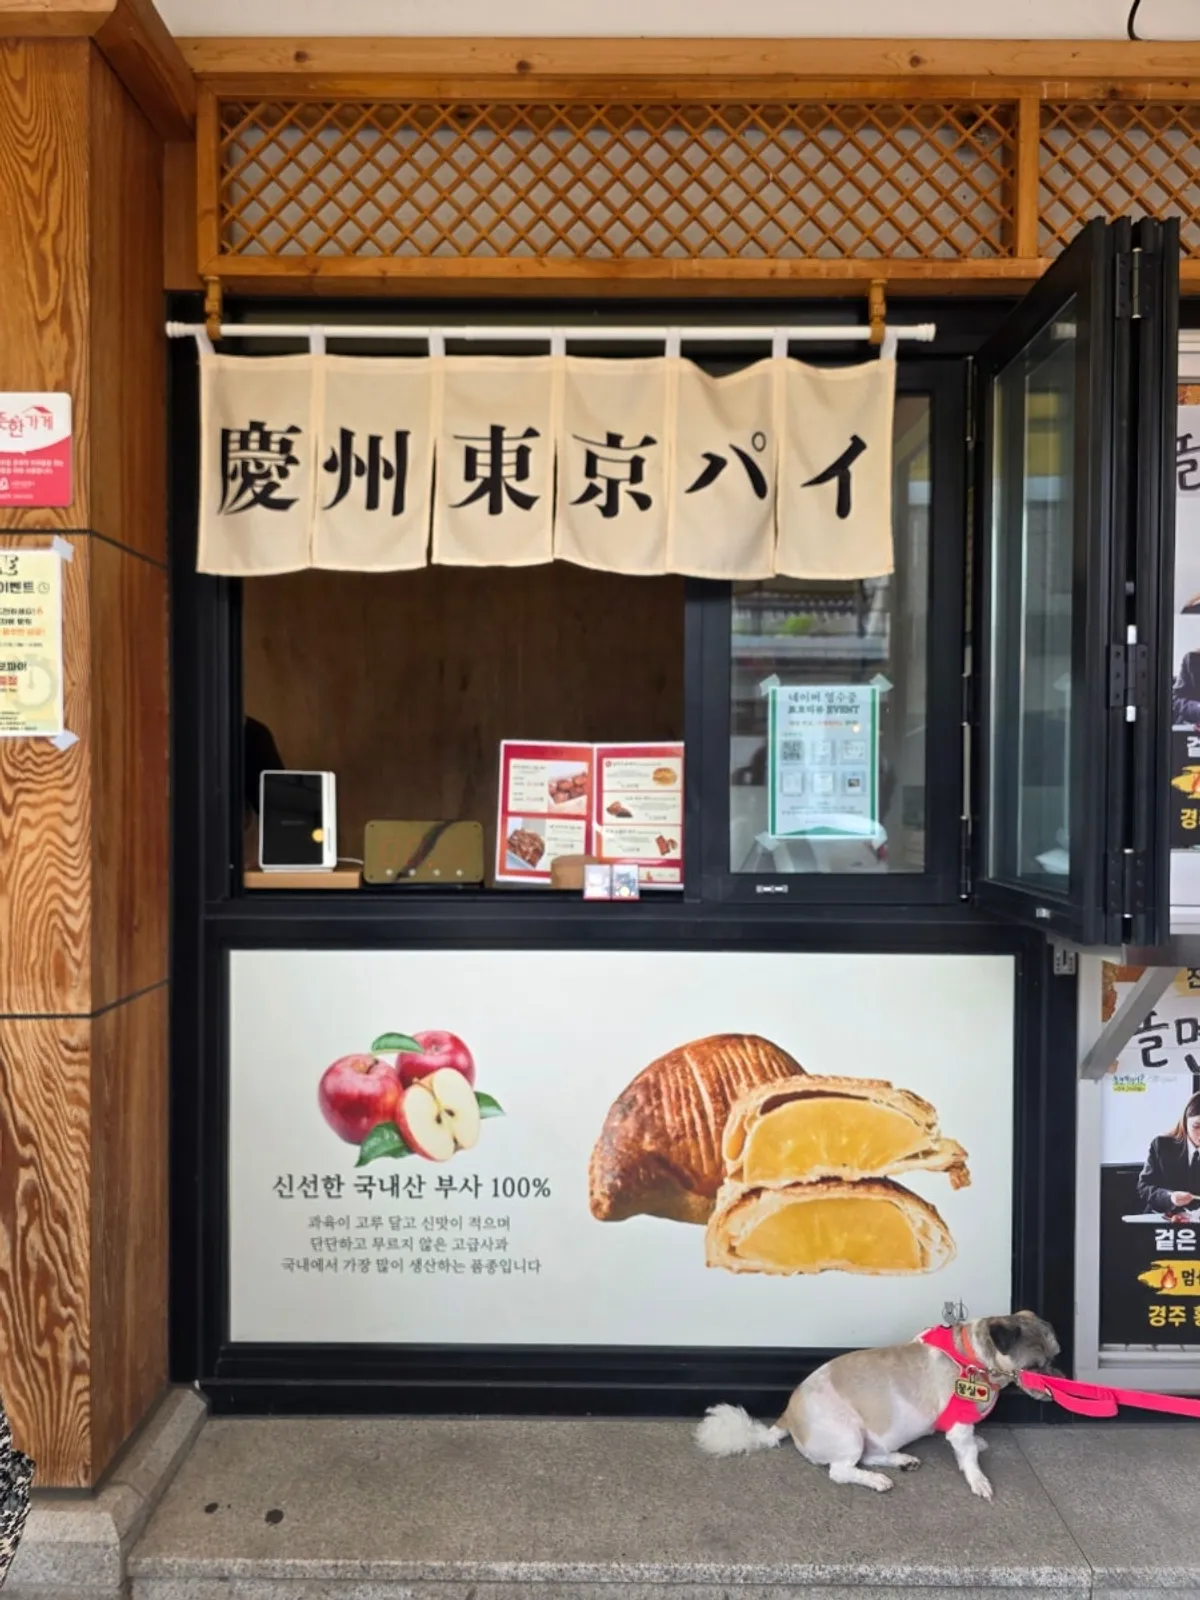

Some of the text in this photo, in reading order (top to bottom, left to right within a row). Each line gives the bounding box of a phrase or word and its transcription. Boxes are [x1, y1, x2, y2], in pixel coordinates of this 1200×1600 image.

[217, 419, 868, 519] 慶州東京パイ
[272, 1173, 551, 1200] 신선한 국내산 부사 100%
[307, 1214, 351, 1231] 과육이
[355, 1214, 385, 1231] 고루
[420, 1214, 463, 1232] 신맛이
[468, 1215, 511, 1232] 적으며
[310, 1236, 509, 1253] 단단하고 무르지 않은 고급사과
[281, 1257, 542, 1275] 국내에서 가장 많이 생산하는 품종입니다
[1148, 1305, 1187, 1328] 경주
